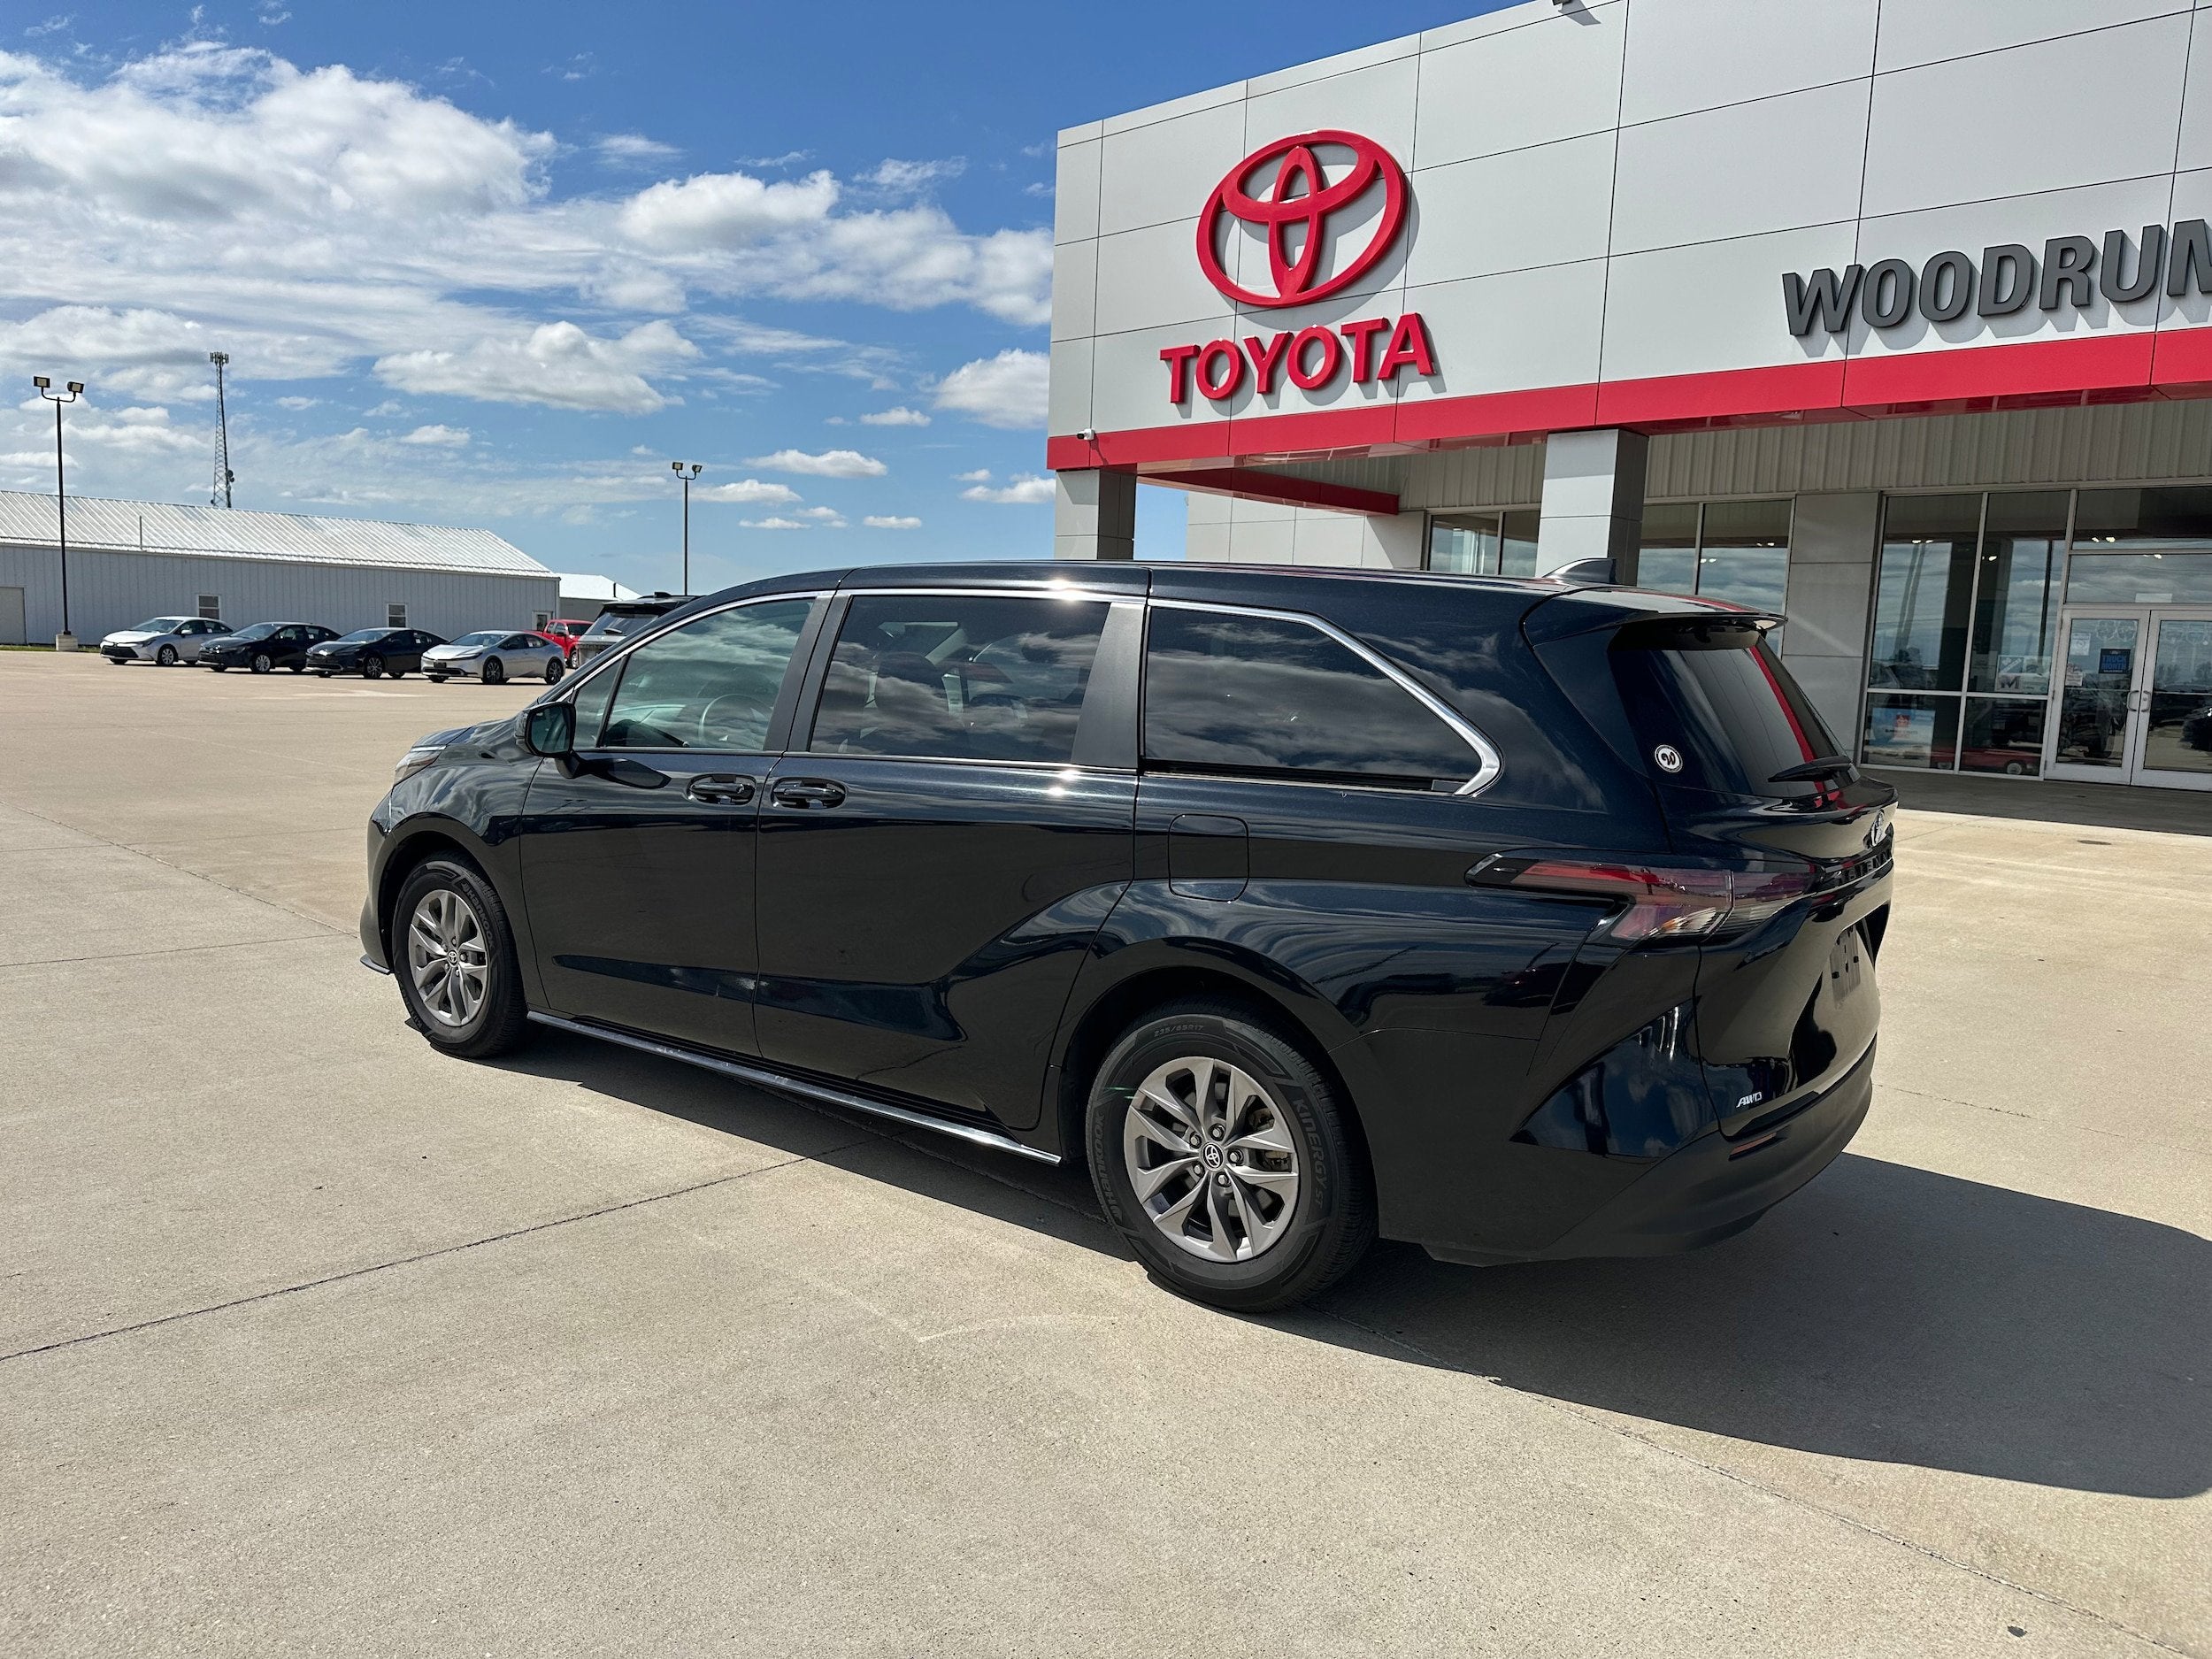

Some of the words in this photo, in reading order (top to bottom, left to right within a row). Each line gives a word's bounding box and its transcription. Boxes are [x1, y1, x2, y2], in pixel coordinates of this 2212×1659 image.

[1159, 312, 1437, 403] TOYOTA
[1293, 1099, 1326, 1189] KINERGY
[1736, 1091, 1763, 1108] AWD
